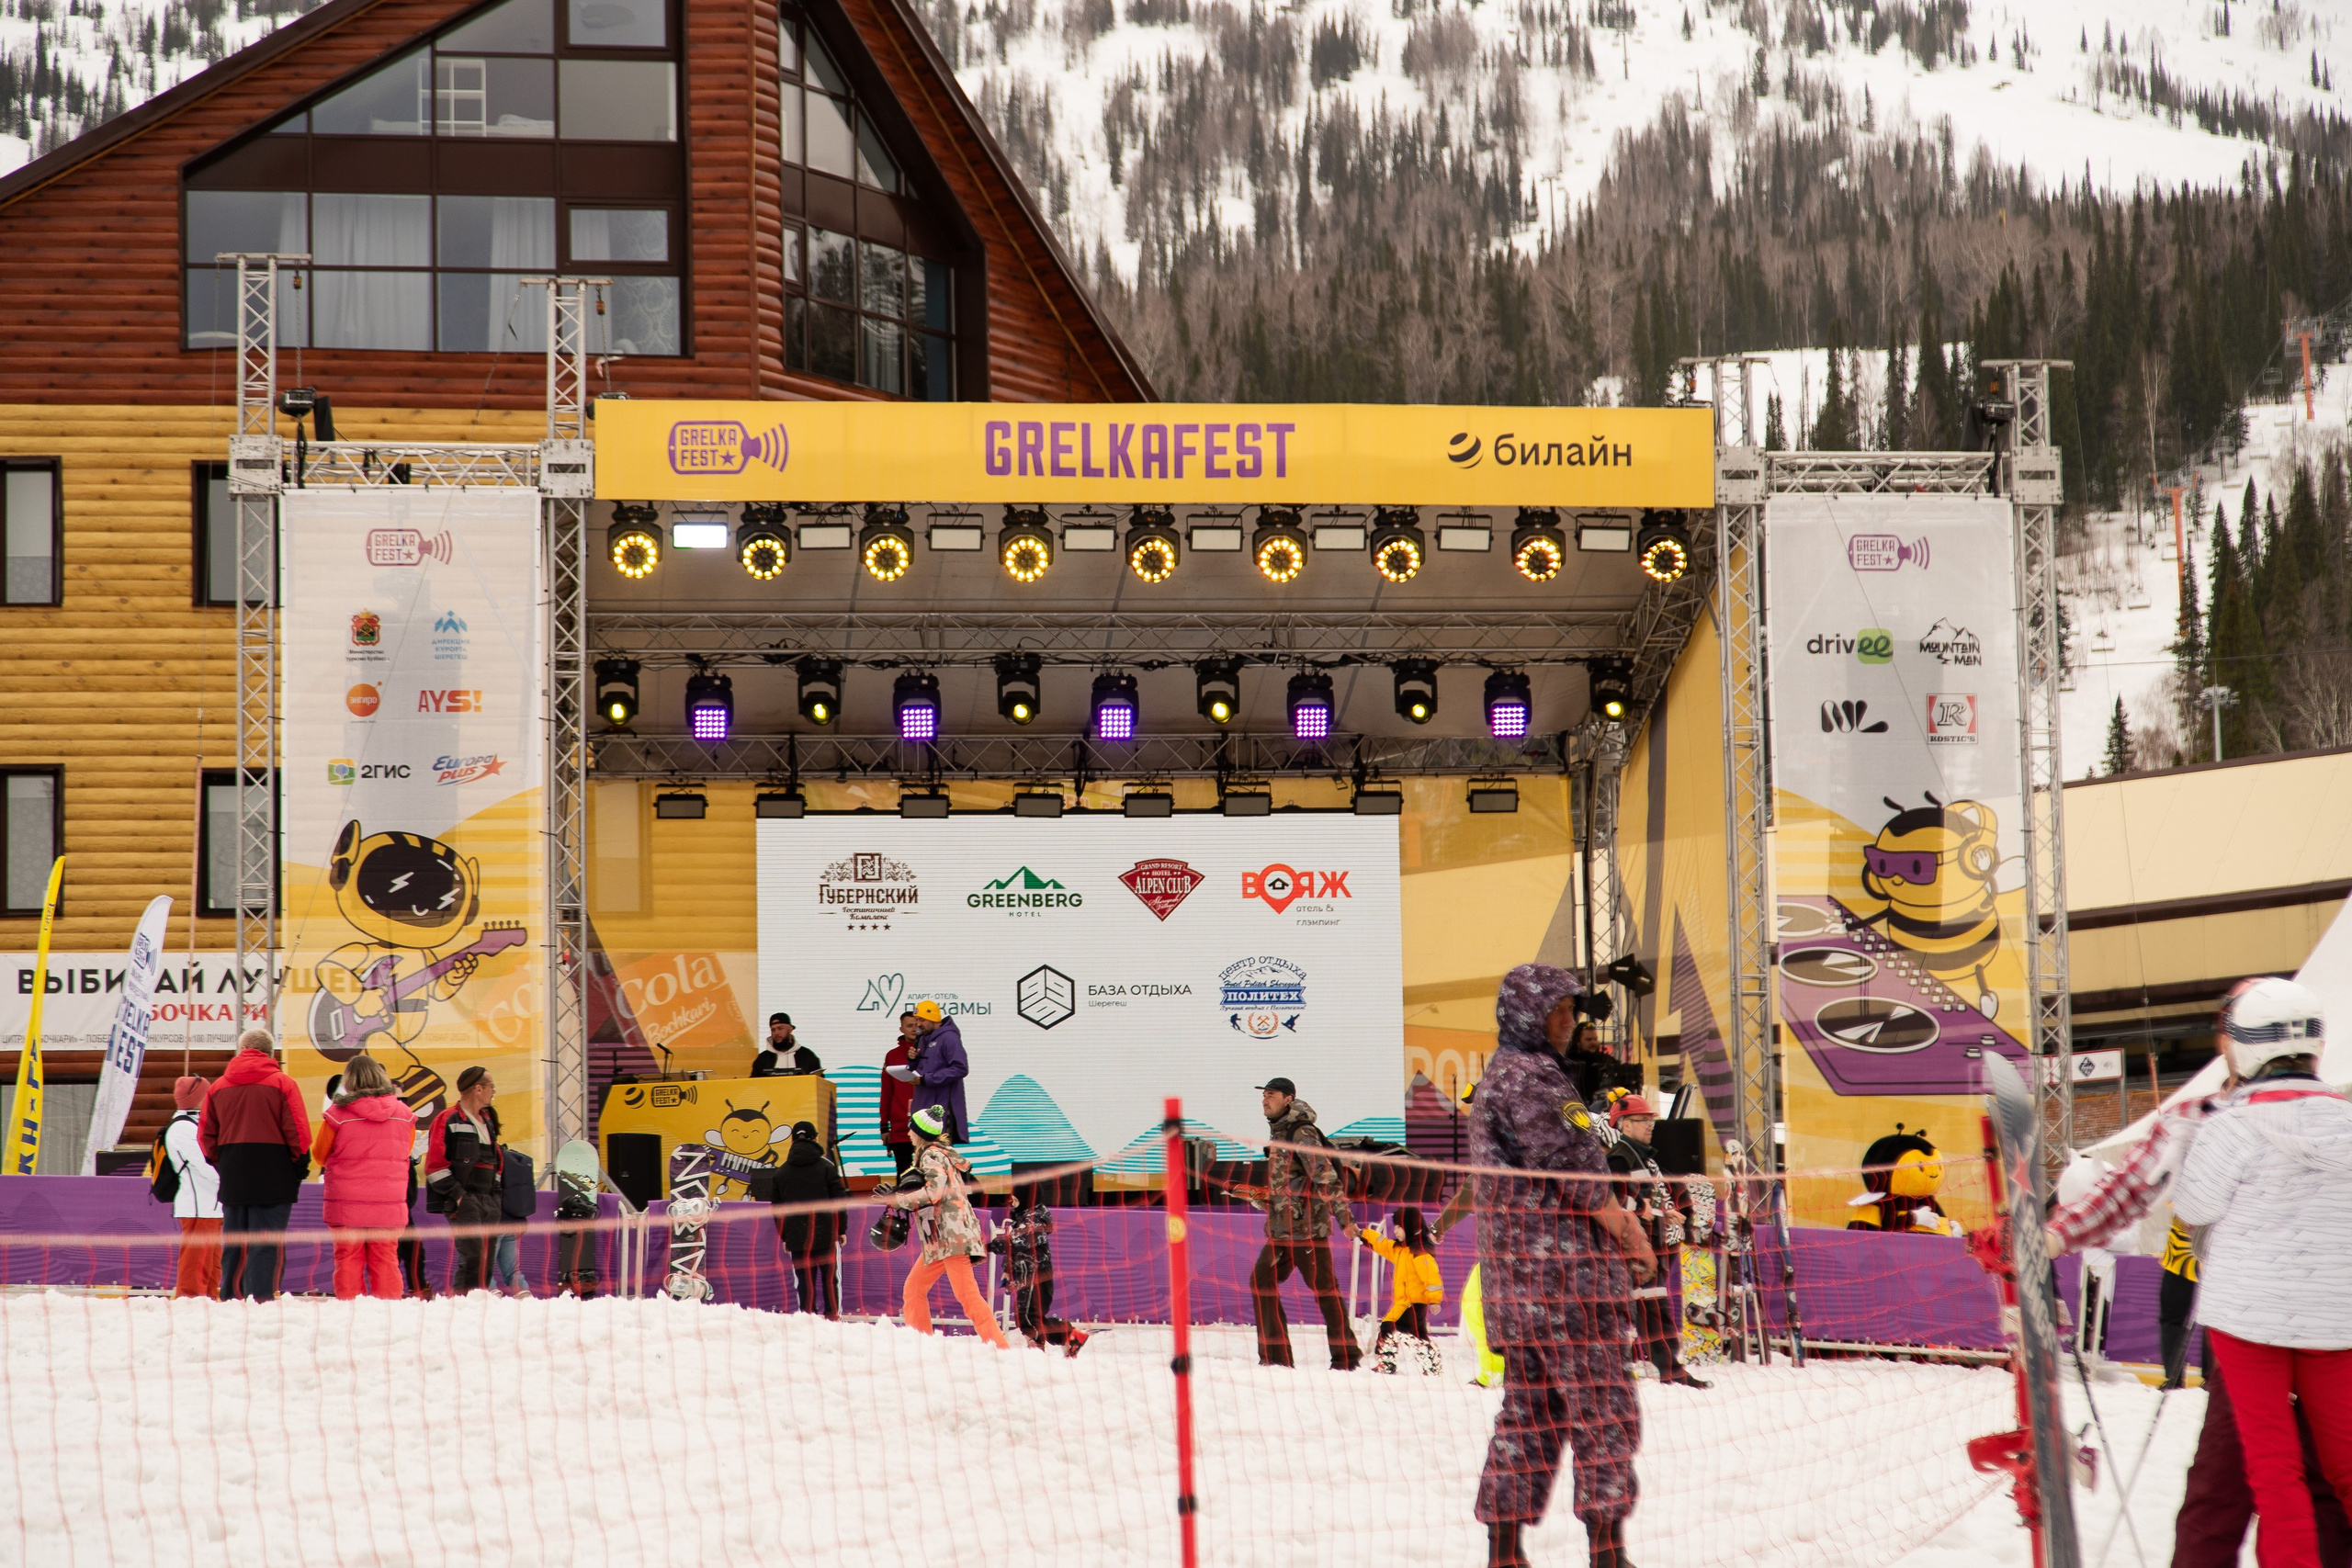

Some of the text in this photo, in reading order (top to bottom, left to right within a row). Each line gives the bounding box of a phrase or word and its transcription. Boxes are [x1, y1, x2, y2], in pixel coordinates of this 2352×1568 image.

[680, 428, 738, 446] GRELKA
[985, 420, 1296, 479] GRELKAFEST
[1494, 432, 1633, 467] билайн
[681, 448, 719, 467] FEST
[374, 534, 416, 547] GRELKA
[1856, 538, 1895, 551] GRELKA
[375, 548, 403, 561] FEST
[1856, 553, 1883, 566] FEST
[1806, 633, 1894, 657] drivee
[1919, 641, 1981, 654] MOUNTAIN
[1954, 654, 1983, 666] MAN
[418, 689, 483, 713] AYS!
[360, 763, 412, 779] 2ГИС
[1135, 874, 1192, 894] ALPEN CLUB
[1241, 863, 1353, 900] ВОЯЖ
[967, 893, 1083, 908] GREENBERG
[1295, 904, 1323, 913] отель
[1296, 919, 1340, 927] глэмпинг
[1218, 955, 1307, 981] центр отдыха
[615, 953, 719, 1020] Cola
[1088, 984, 1193, 998] БАЗА ОТДЫХА
[1227, 991, 1300, 1001] ПОЛИТЕХ
[1088, 999, 1127, 1009] Шерегеш
[645, 997, 712, 1045] Bochkari
[655, 1088, 679, 1097] GRELKA
[655, 1097, 672, 1105] FEST
